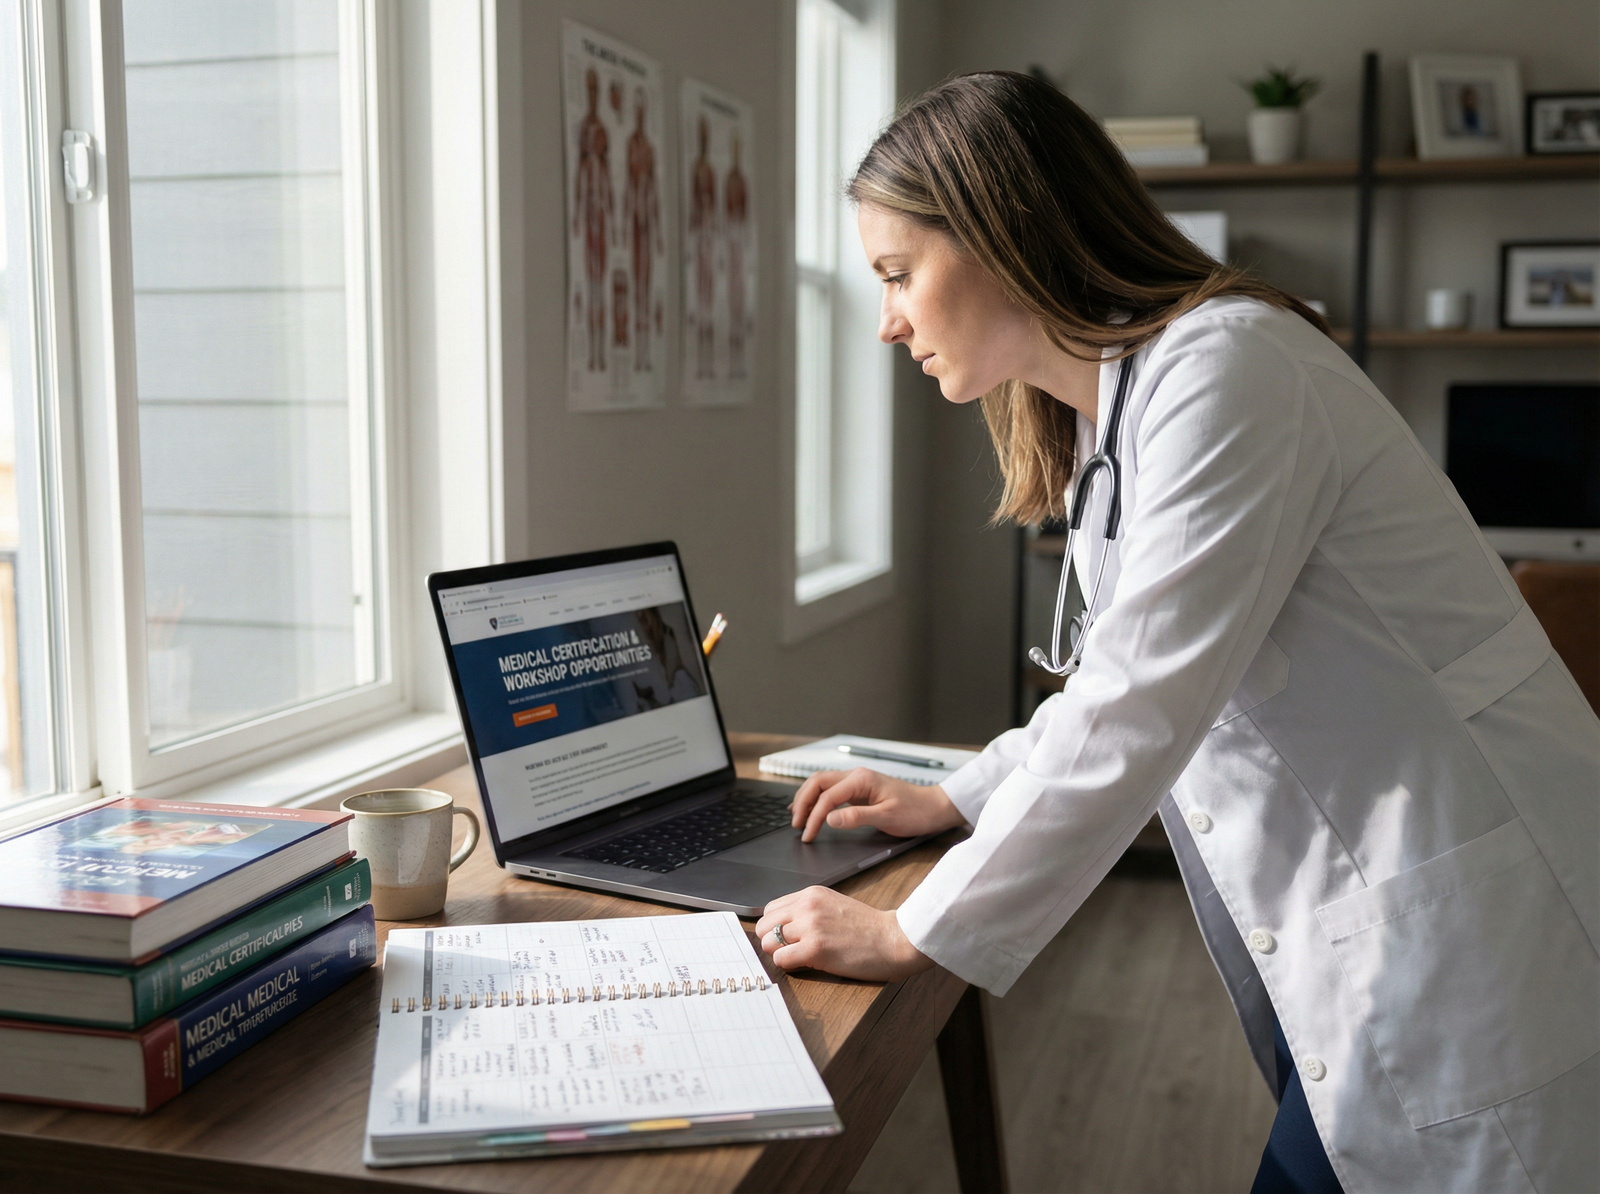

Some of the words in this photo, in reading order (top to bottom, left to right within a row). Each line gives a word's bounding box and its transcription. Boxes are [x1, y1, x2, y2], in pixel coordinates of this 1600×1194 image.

[498, 648, 551, 673] MEDICAL
[551, 631, 630, 662] CERTIFICATION
[629, 629, 640, 645] &
[503, 663, 568, 692] WORKSHOP
[569, 645, 652, 677] OPPORTUNITIES
[181, 961, 228, 992] MEDICAL
[186, 999, 246, 1050] MEDICAL
[247, 965, 301, 1012] MEDICAL
[196, 1028, 237, 1065] MEDICAL
